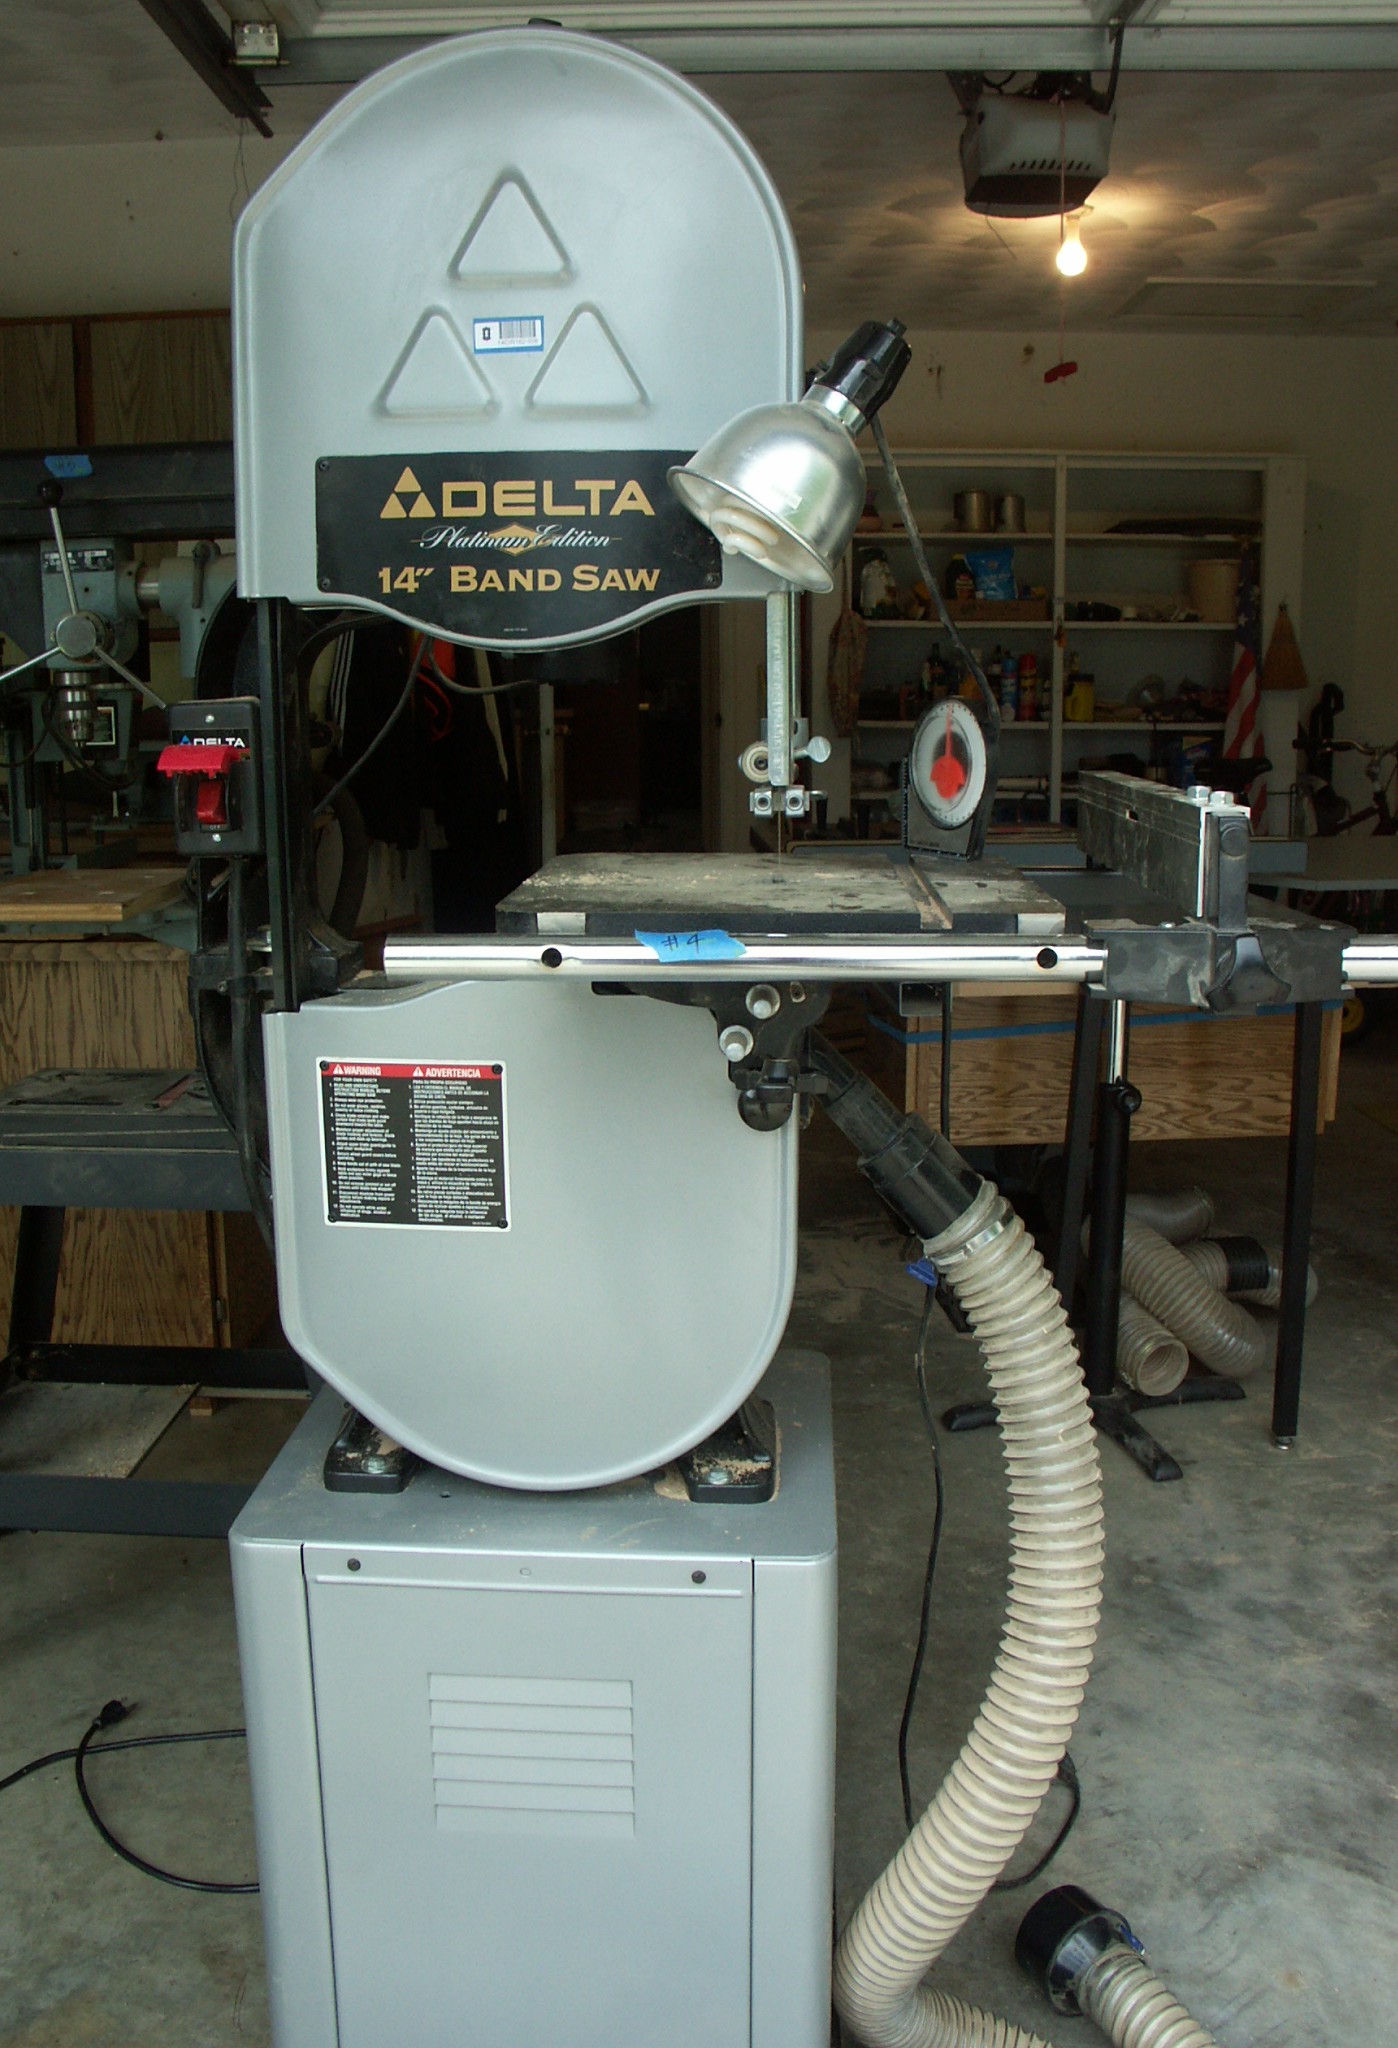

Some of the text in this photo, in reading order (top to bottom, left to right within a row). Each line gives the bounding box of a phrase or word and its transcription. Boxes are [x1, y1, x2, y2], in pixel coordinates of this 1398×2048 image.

[443, 480, 655, 516] DELTA
[420, 524, 610, 549] Platinum Edition
[379, 564, 660, 593] 14" BAND SAW
[343, 1065, 381, 1076] WARNING
[425, 1068, 481, 1078] ADVERTENCIA
